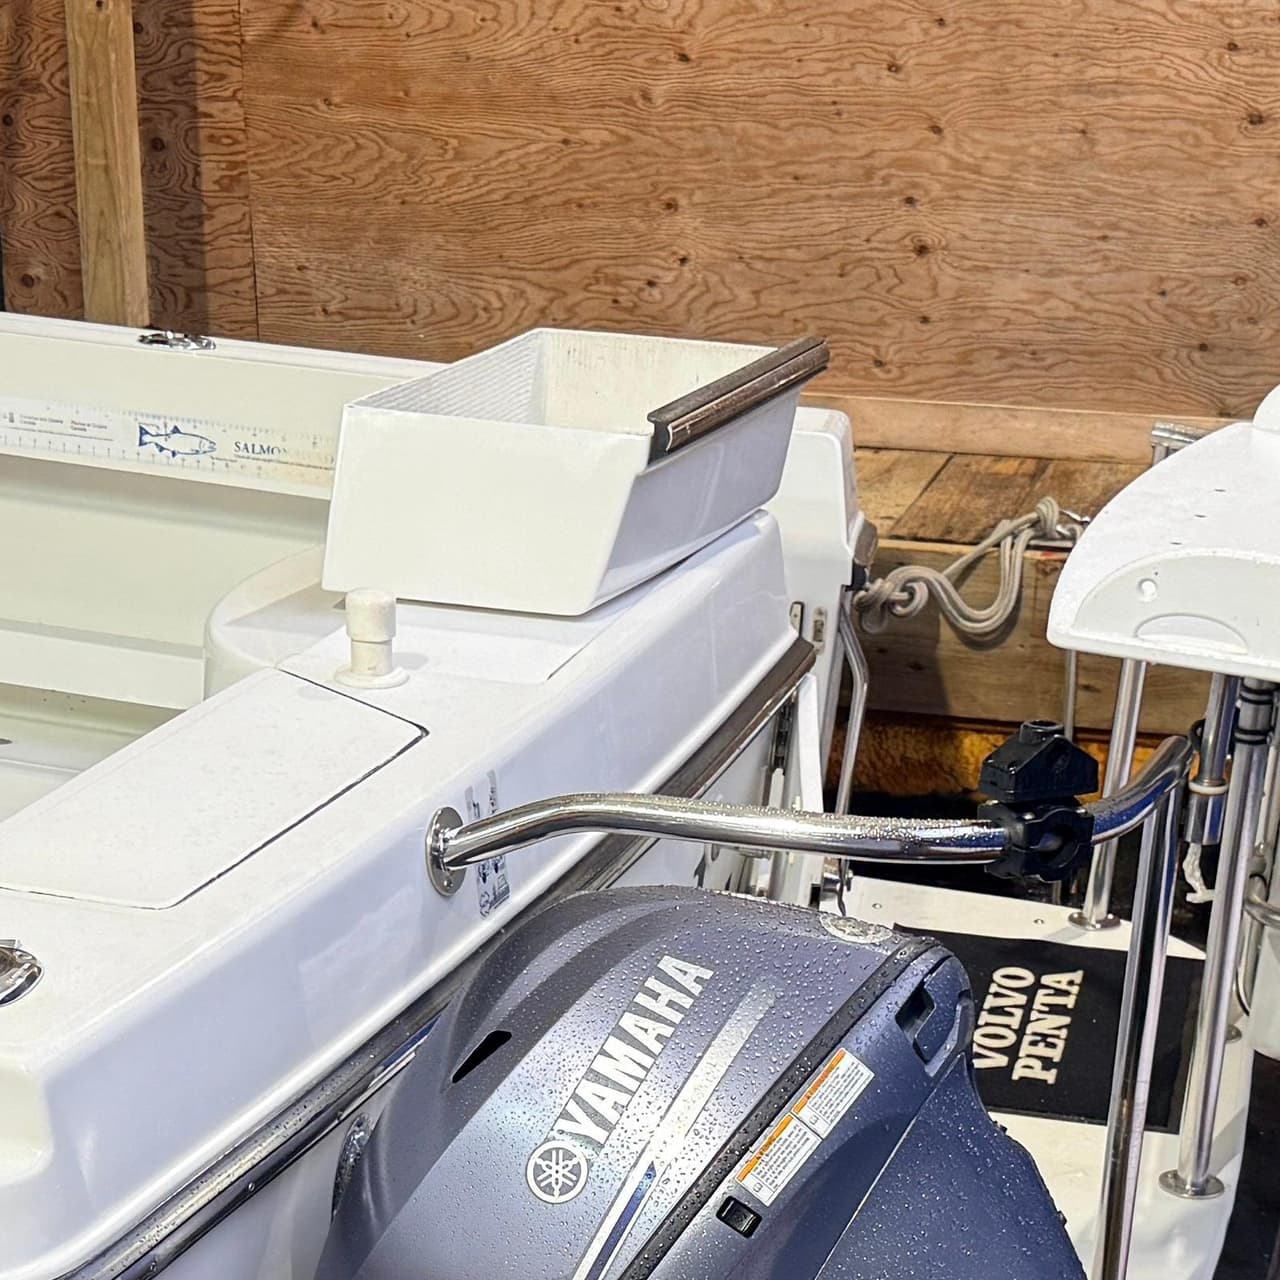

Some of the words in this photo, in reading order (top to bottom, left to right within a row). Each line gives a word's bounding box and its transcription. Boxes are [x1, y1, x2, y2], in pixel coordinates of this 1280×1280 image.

[552, 955, 715, 1145] YAMAHA
[972, 966, 1036, 1069] VOLVO
[1011, 969, 1084, 1086] PENTA
